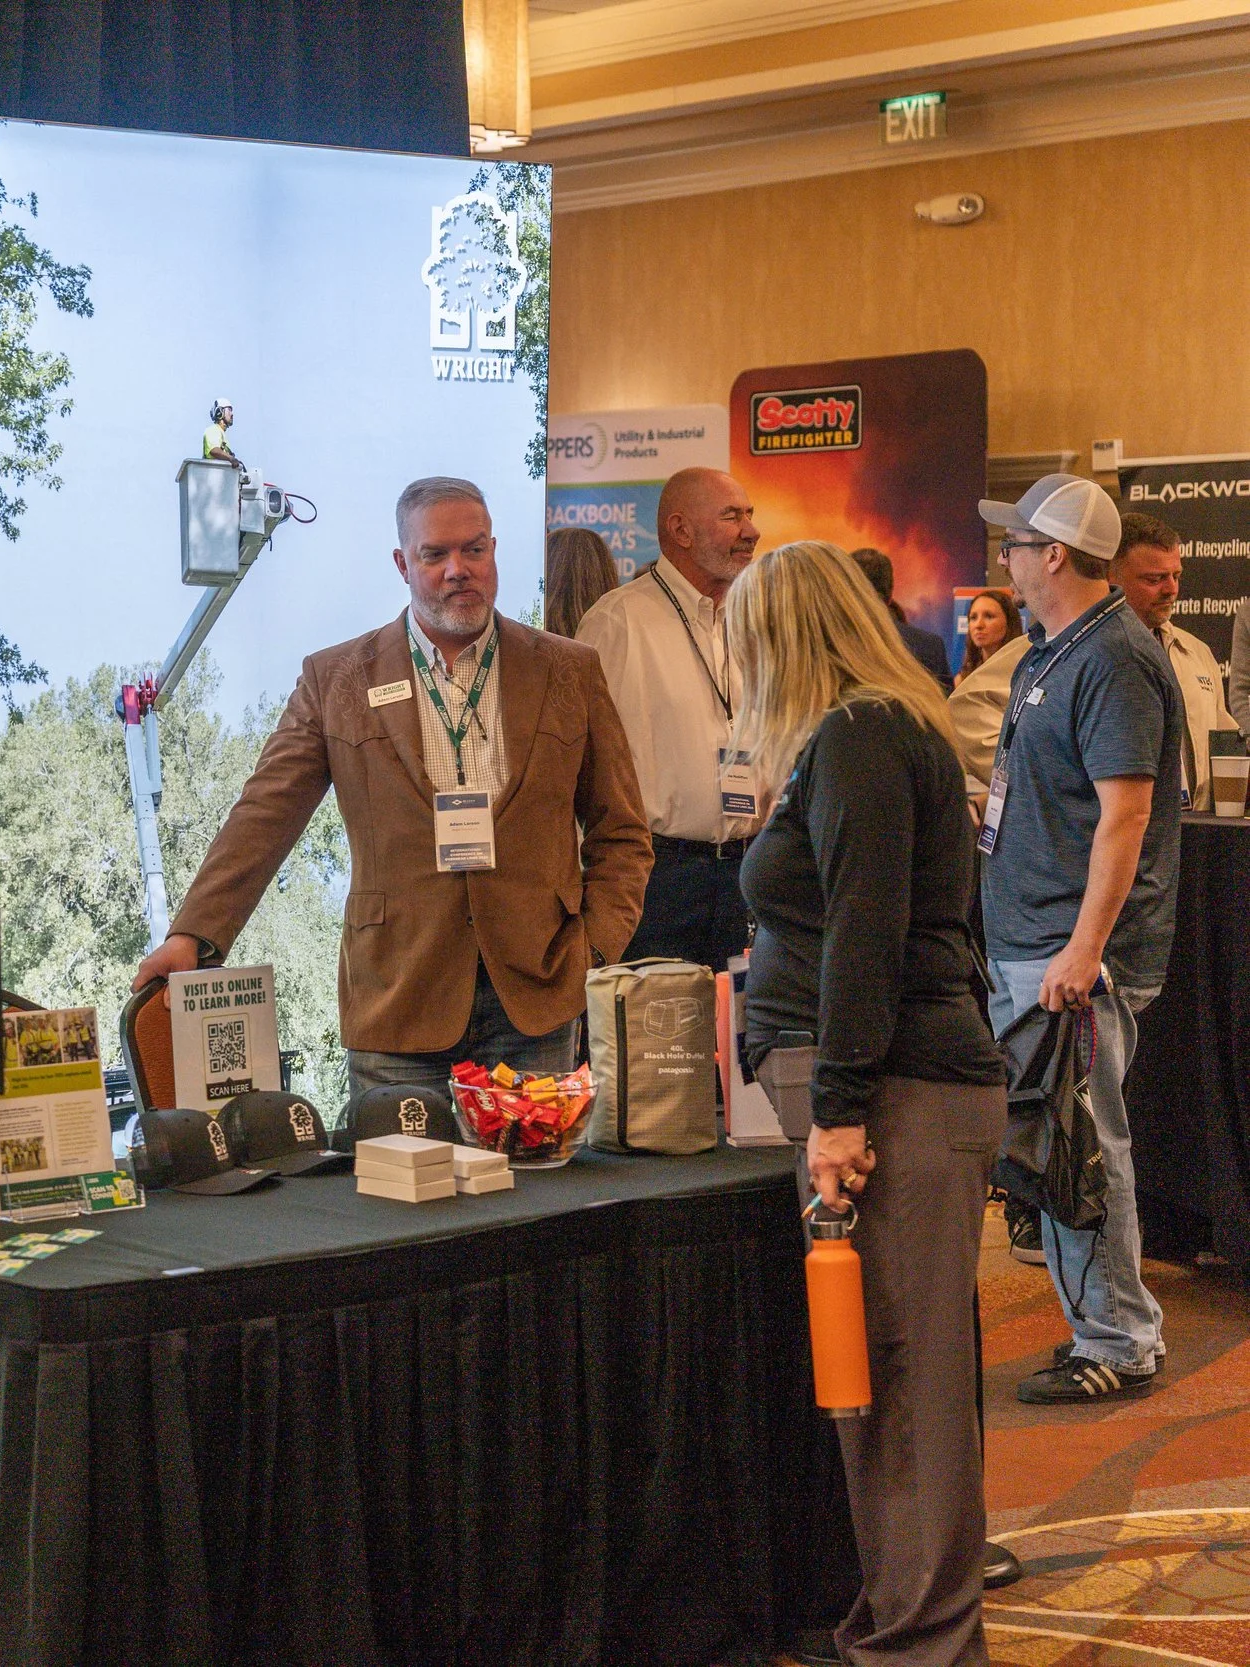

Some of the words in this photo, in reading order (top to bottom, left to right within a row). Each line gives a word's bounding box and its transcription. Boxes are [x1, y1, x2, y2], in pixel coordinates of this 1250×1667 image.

[886, 95, 941, 143] EXIT
[431, 355, 514, 382] WRIGHT
[757, 397, 854, 431] Scotty
[614, 431, 645, 444] Utility
[647, 431, 655, 442] &
[657, 427, 705, 440] Industrial
[758, 430, 854, 449] FIREFIGHTER
[614, 448, 658, 459] Products
[184, 983, 208, 997] VISIT
[212, 981, 224, 994] US
[228, 977, 263, 992] ONLINE
[183, 1000, 195, 1012] TO
[200, 995, 230, 1010] LEARN
[234, 991, 266, 1006] MORE!
[210, 1086, 230, 1097] SCAN
[231, 1083, 250, 1094] HERE
